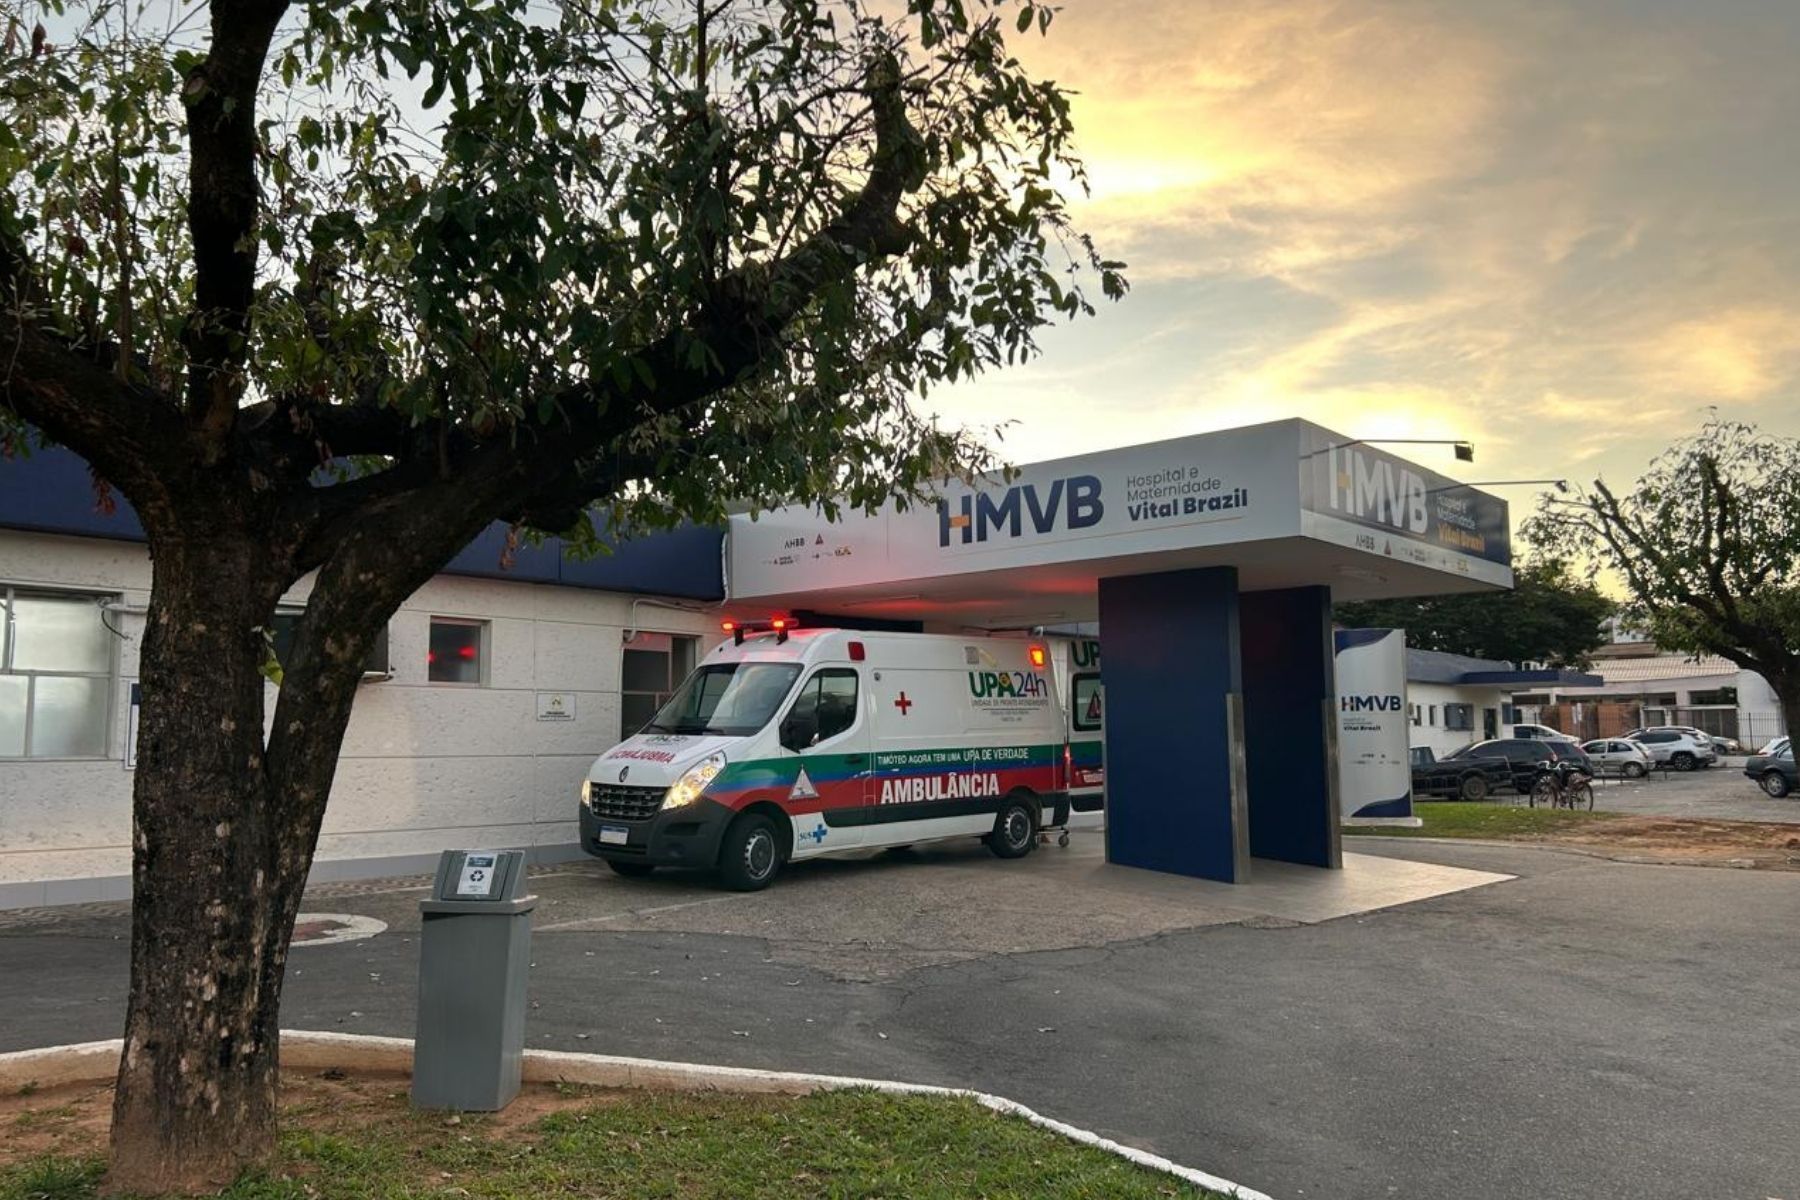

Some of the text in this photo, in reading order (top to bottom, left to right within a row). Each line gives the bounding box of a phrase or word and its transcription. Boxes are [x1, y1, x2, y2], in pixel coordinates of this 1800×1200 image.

[1127, 467, 1198, 488] Hospital e
[1127, 478, 1221, 502] Maternidade
[1329, 442, 1428, 534] HMVB
[939, 475, 1104, 547] HMVB
[1128, 489, 1247, 522] Vital Brazil
[1341, 695, 1402, 712] HMVB
[908, 752, 931, 763] AGORA
[963, 750, 980, 762] UPA
[981, 749, 993, 761] DE
[993, 747, 1029, 760] VERDADE
[881, 772, 1000, 805] AMBULÂNCIA
